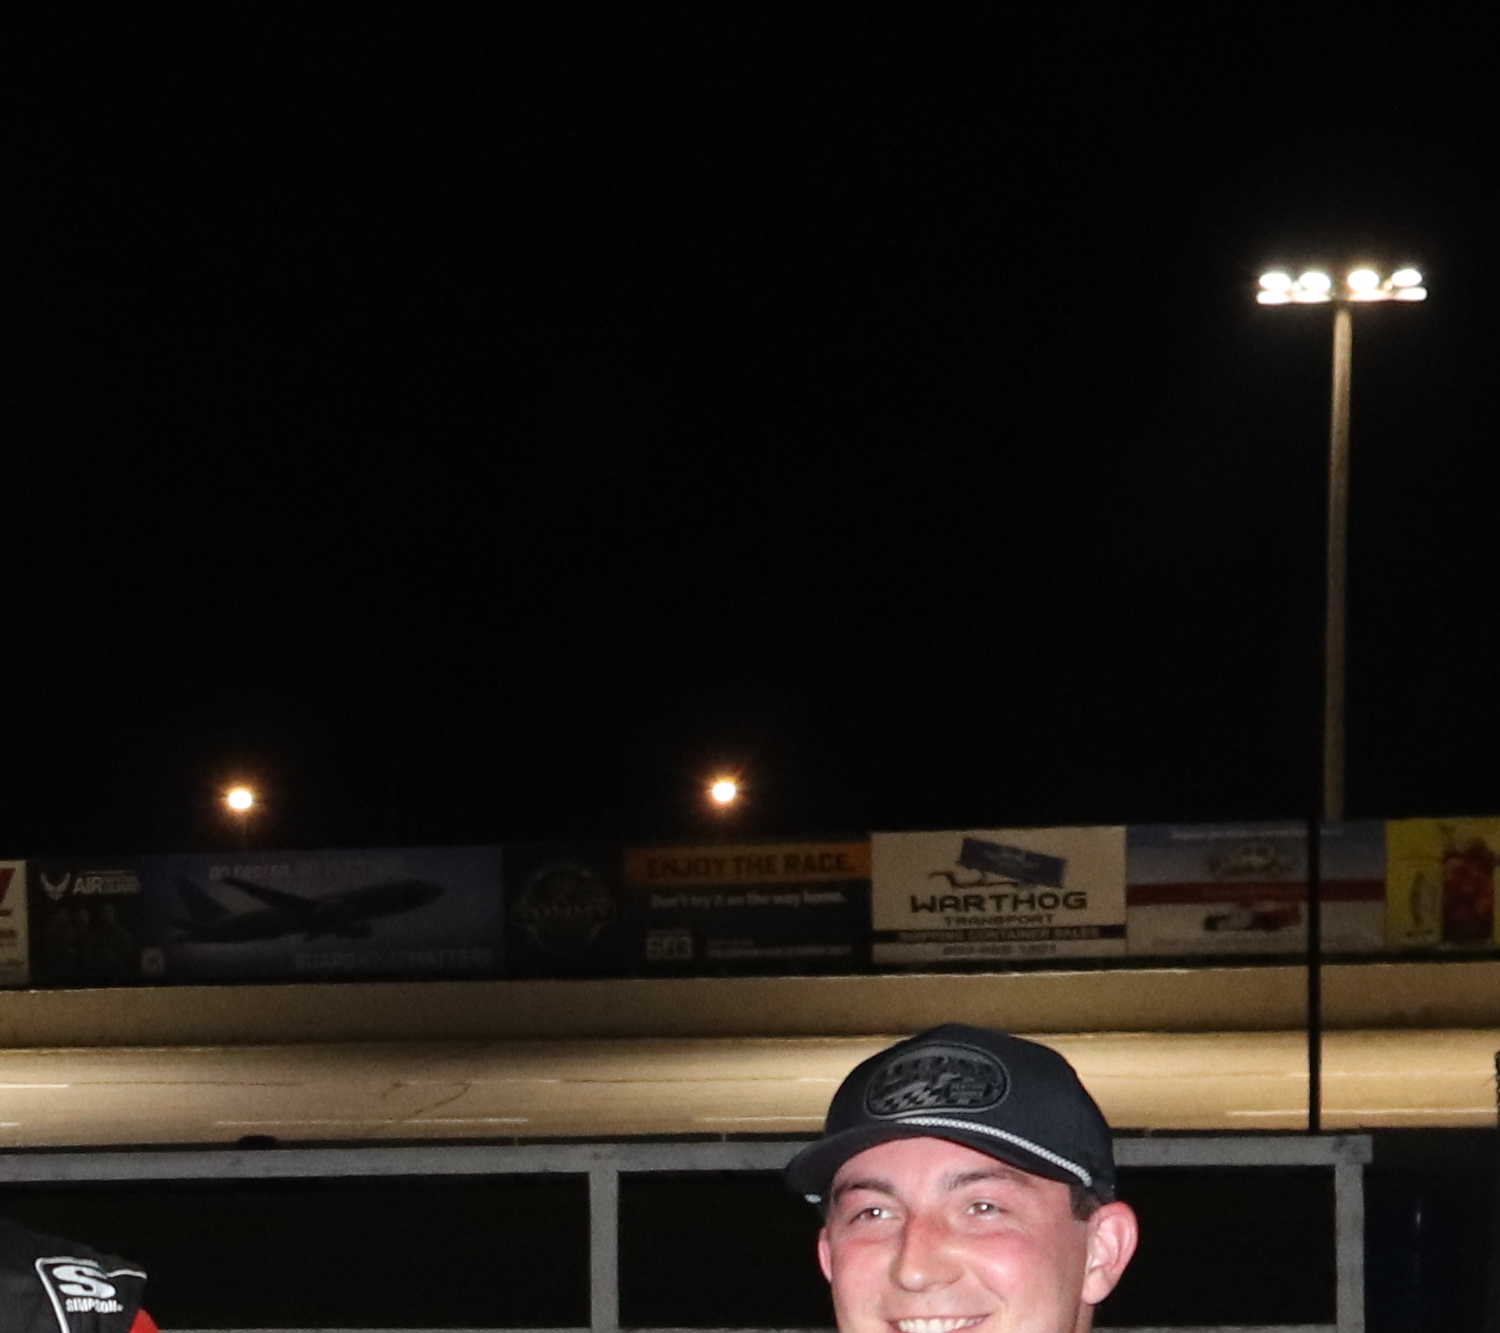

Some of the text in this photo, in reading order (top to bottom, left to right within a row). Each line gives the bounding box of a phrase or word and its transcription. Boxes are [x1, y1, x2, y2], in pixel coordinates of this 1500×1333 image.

[647, 855, 729, 879] ENJOY
[731, 854, 778, 875] THE
[909, 890, 1088, 914] WARTHOG
